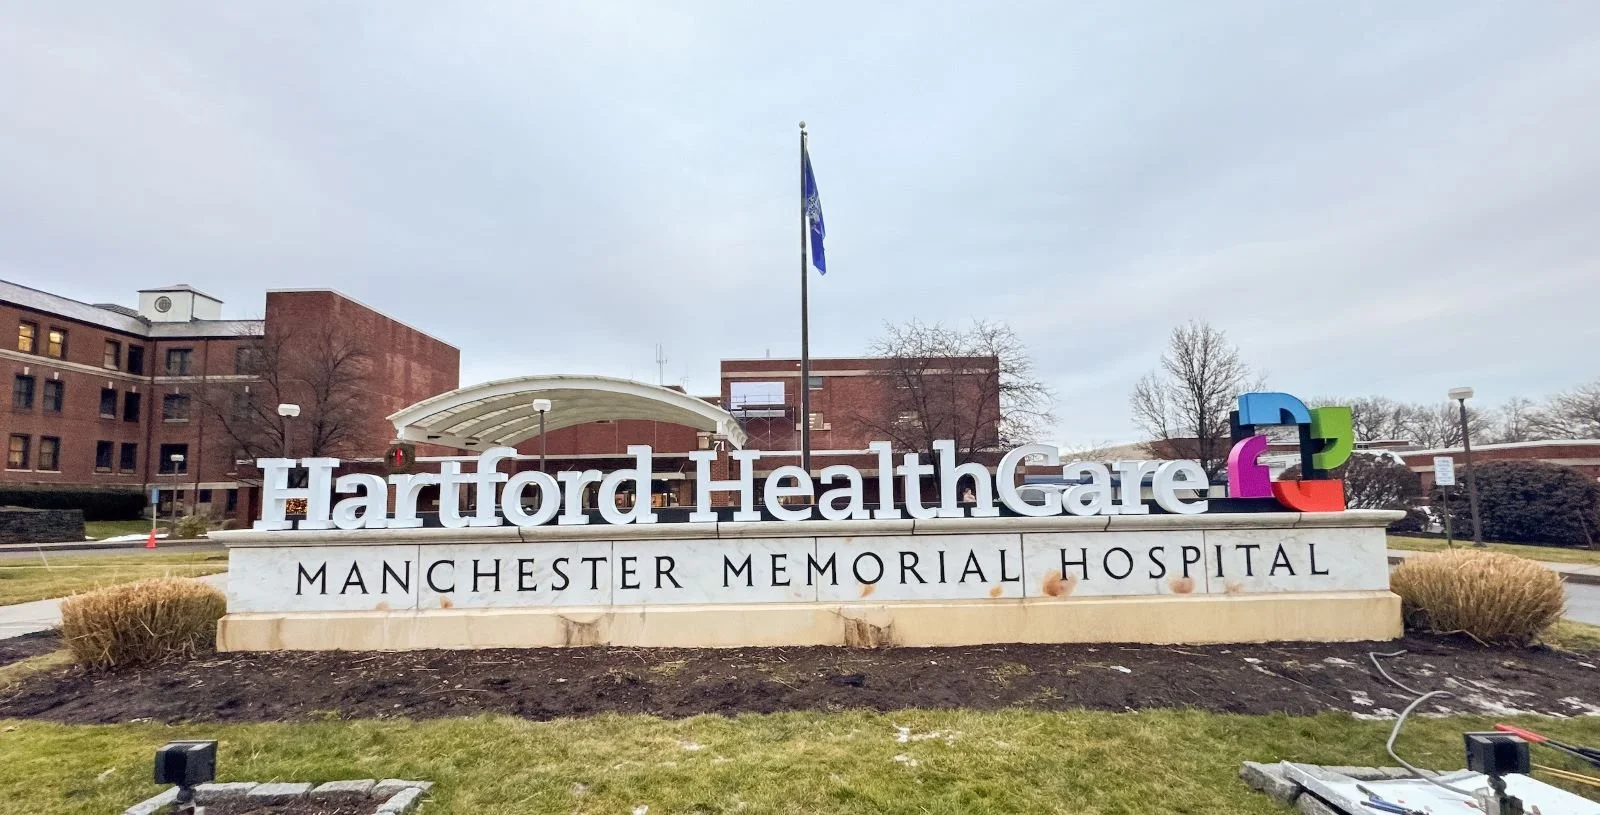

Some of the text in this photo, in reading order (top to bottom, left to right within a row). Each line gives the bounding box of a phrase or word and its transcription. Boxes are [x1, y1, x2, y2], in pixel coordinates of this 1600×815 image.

[713, 440, 725, 452] 71
[253, 440, 1209, 530] Hartford HealthCare
[295, 543, 1329, 596] MANCHESTER MEMORIAL HOSPITAL
